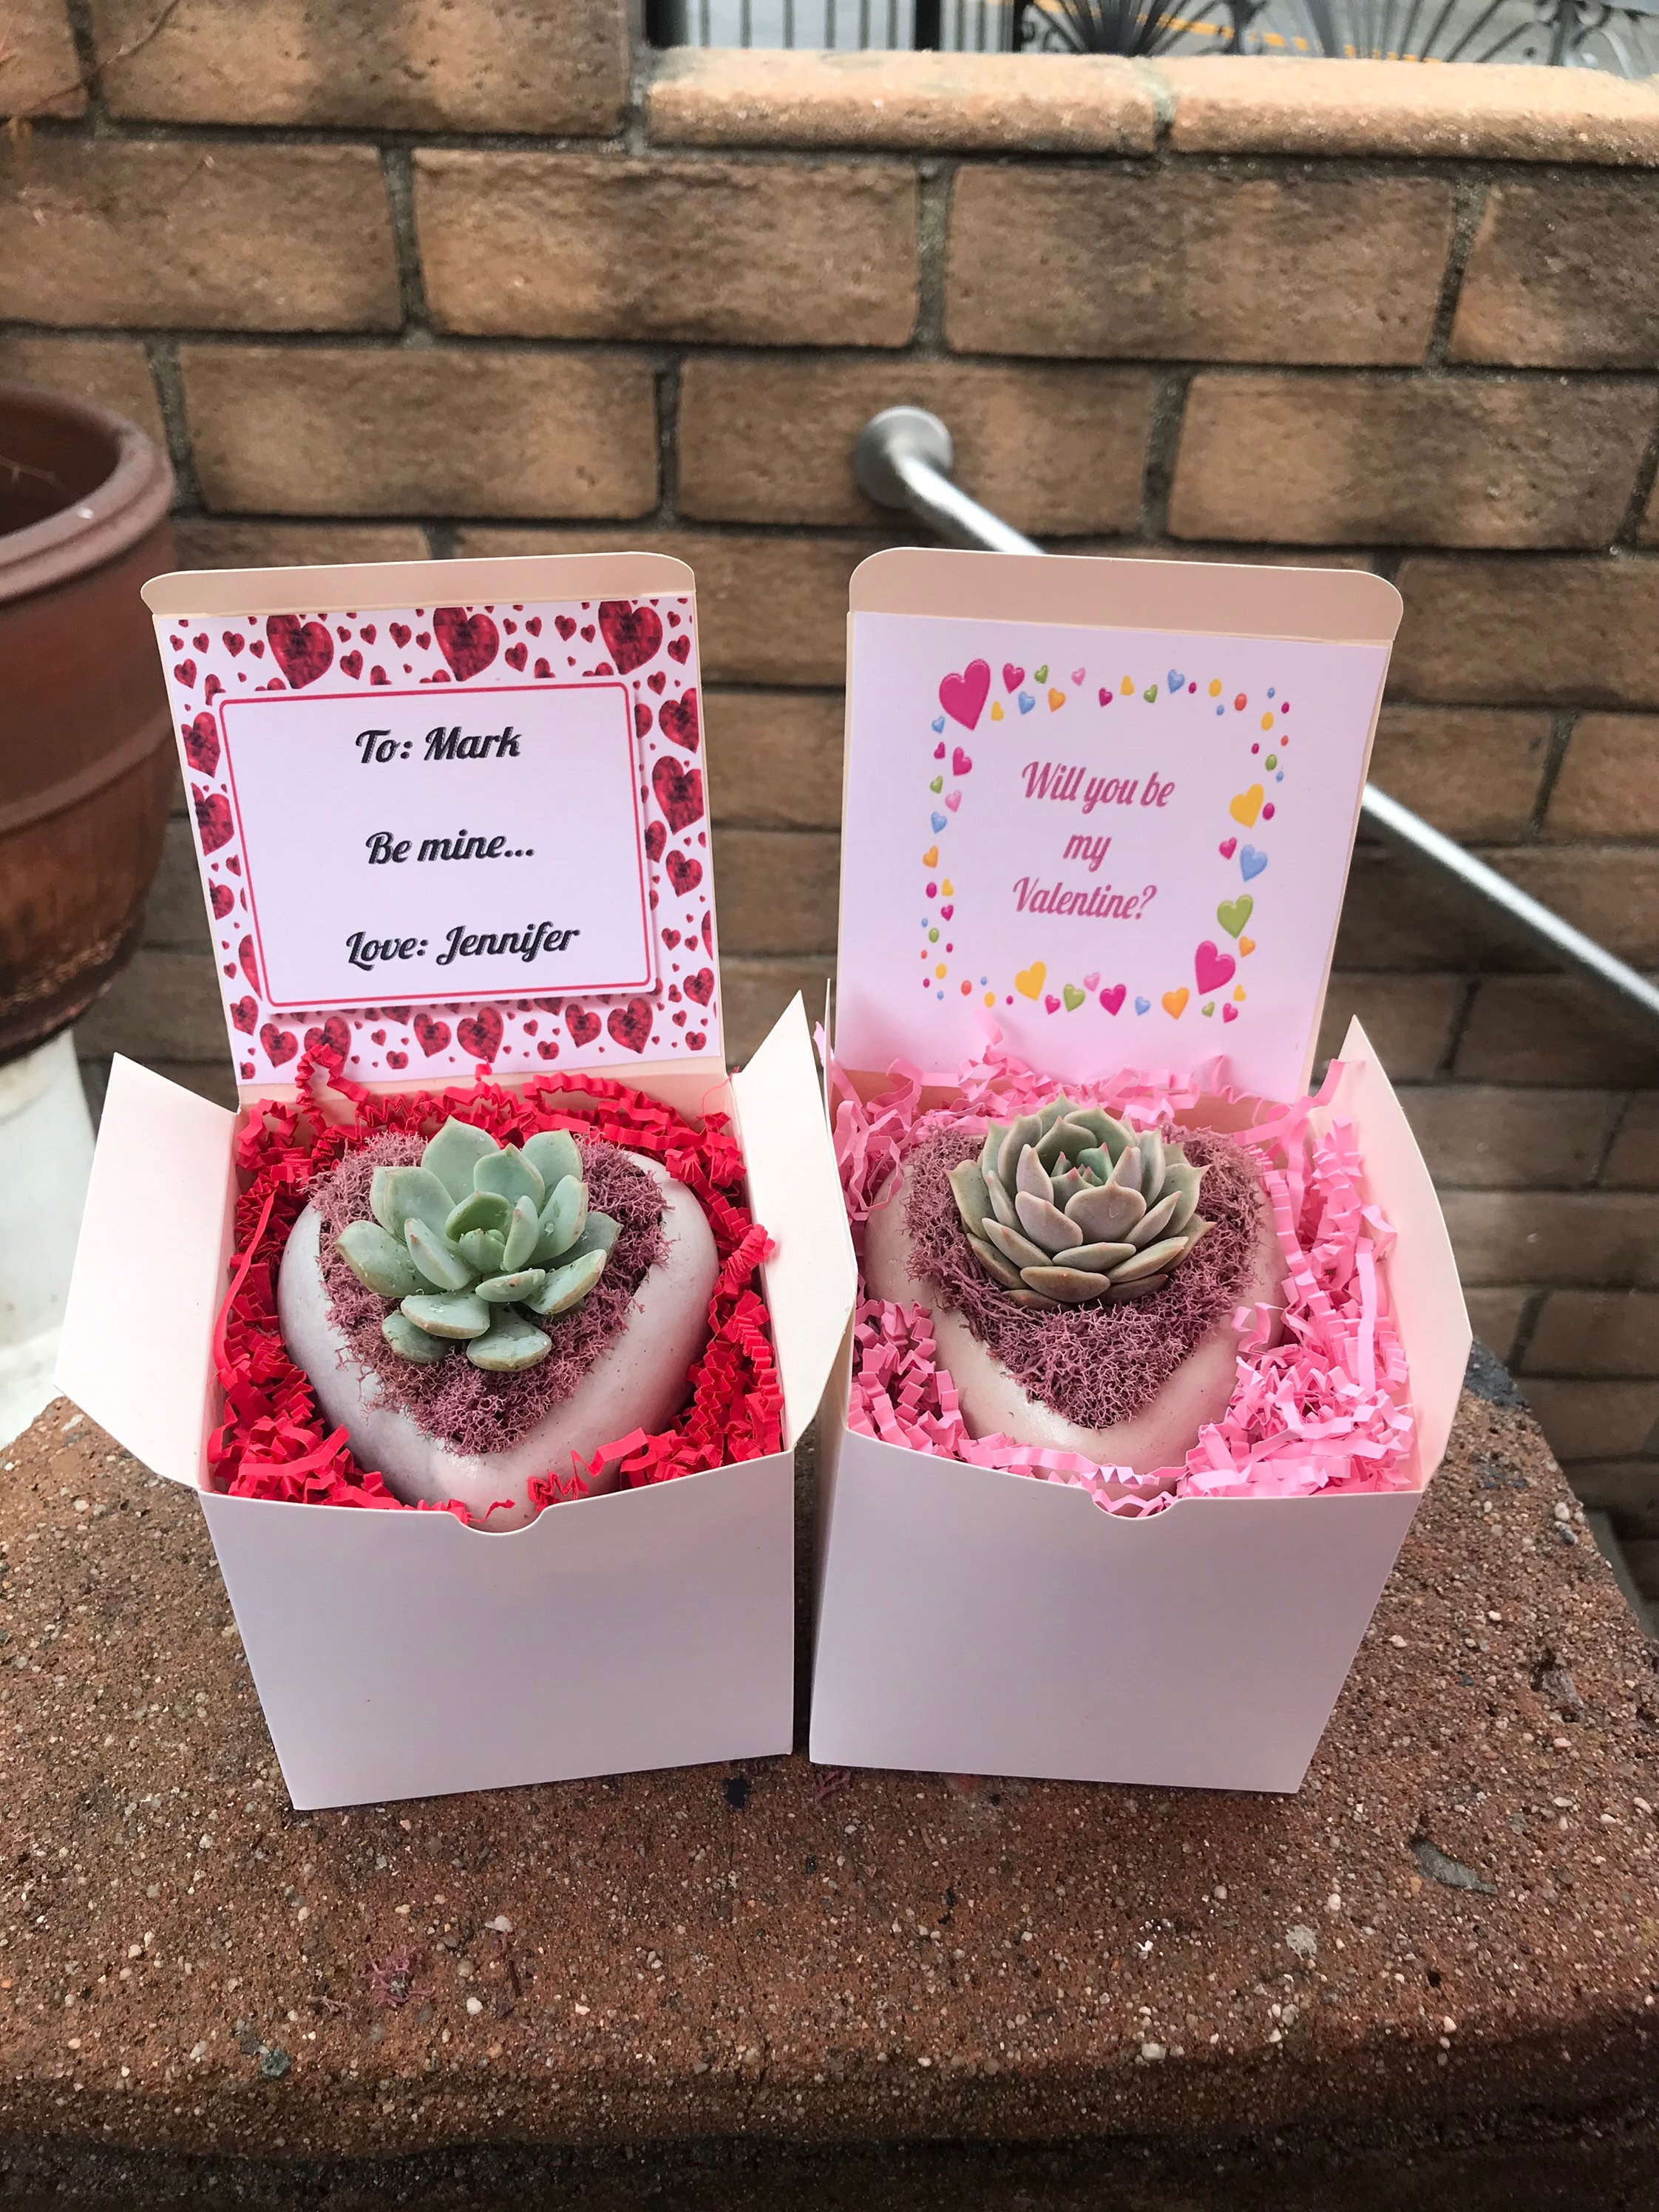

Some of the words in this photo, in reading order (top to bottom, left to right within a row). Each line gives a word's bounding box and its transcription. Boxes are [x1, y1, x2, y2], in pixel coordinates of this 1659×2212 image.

[355, 729, 413, 764] To:
[423, 725, 523, 761] Mark
[1022, 761, 1086, 801] Will
[1081, 776, 1139, 815] you
[1139, 771, 1175, 808] be
[364, 831, 413, 865] Be
[416, 828, 535, 862] mine...
[1062, 834, 1112, 873] my
[1012, 876, 1158, 920] Valentine?
[345, 931, 429, 972] Love:
[435, 920, 581, 966] Jennifer
